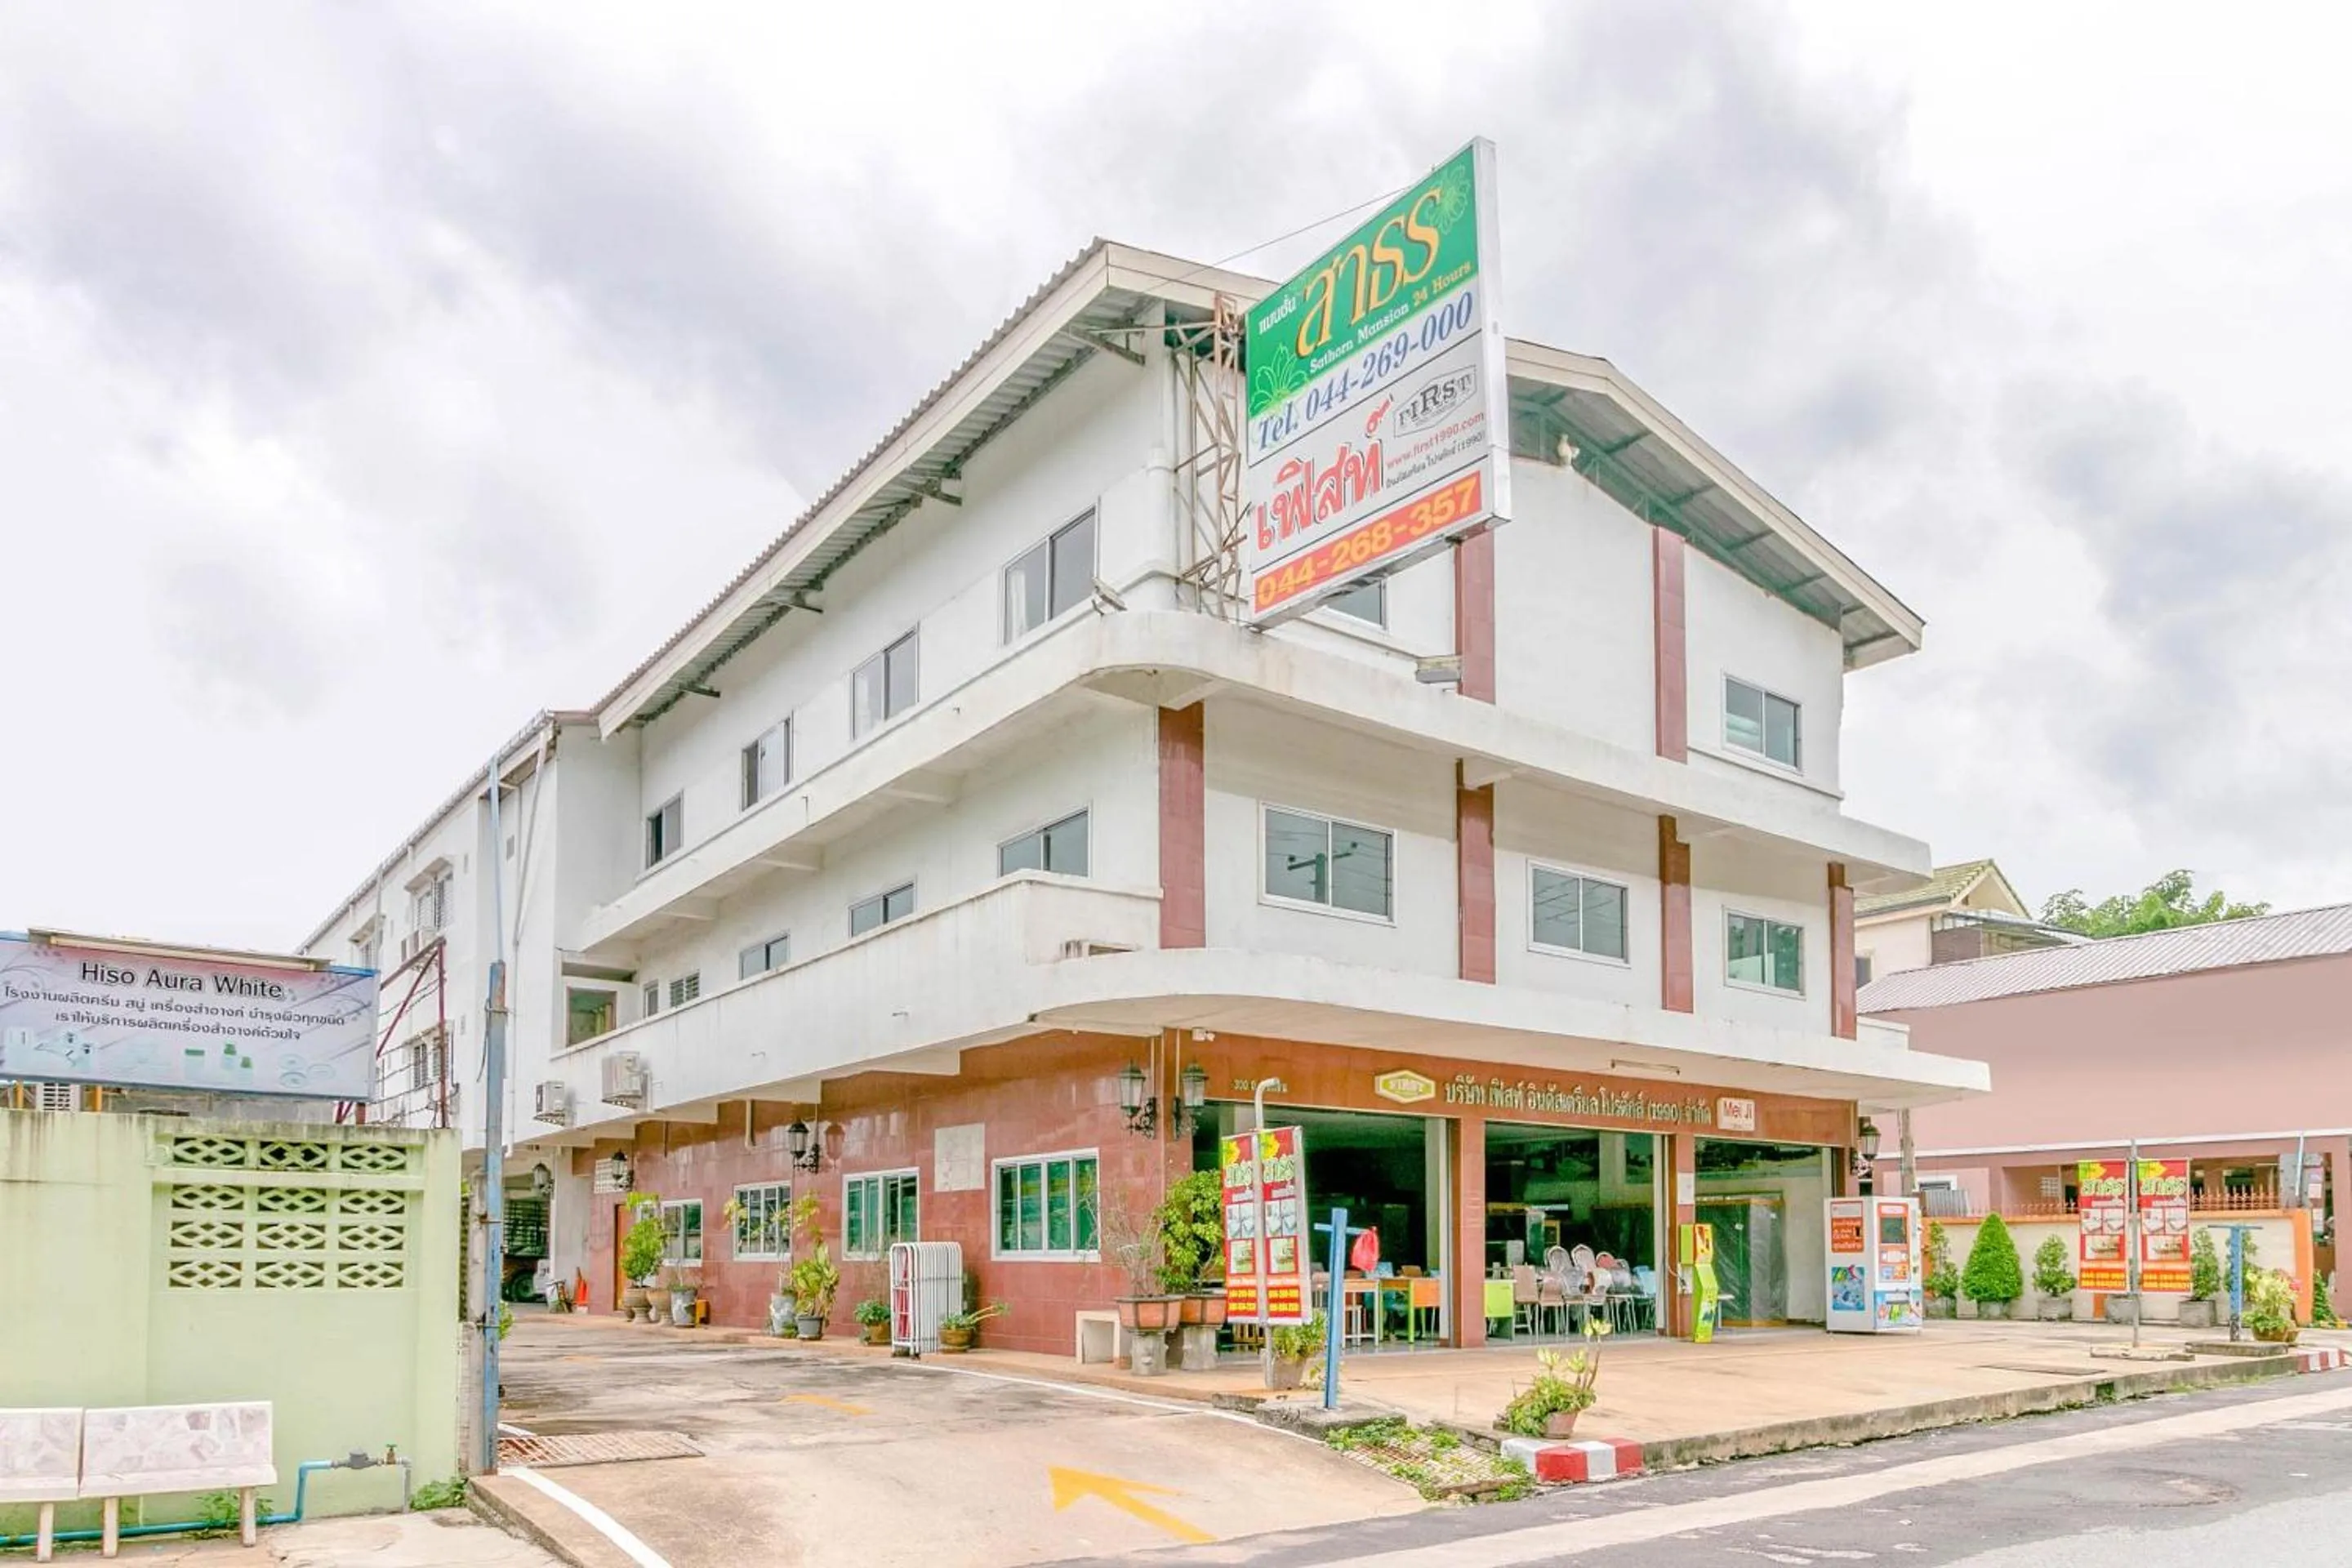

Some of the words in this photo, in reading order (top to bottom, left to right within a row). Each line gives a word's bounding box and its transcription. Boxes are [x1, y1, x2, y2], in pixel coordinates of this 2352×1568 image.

[1258, 401, 1298, 451] Tel.
[1306, 292, 1472, 421] 044-269-000
[1310, 339, 1353, 374] Sathorn
[1357, 303, 1410, 344] Mansion
[1412, 286, 1428, 307] 24
[1432, 261, 1472, 294] Hours
[1258, 476, 1478, 607] 044-268-357
[82, 961, 135, 985] Hiso
[146, 968, 203, 991] Aura
[214, 975, 283, 999] White
[1444, 1074, 1486, 1105] บริษัท
